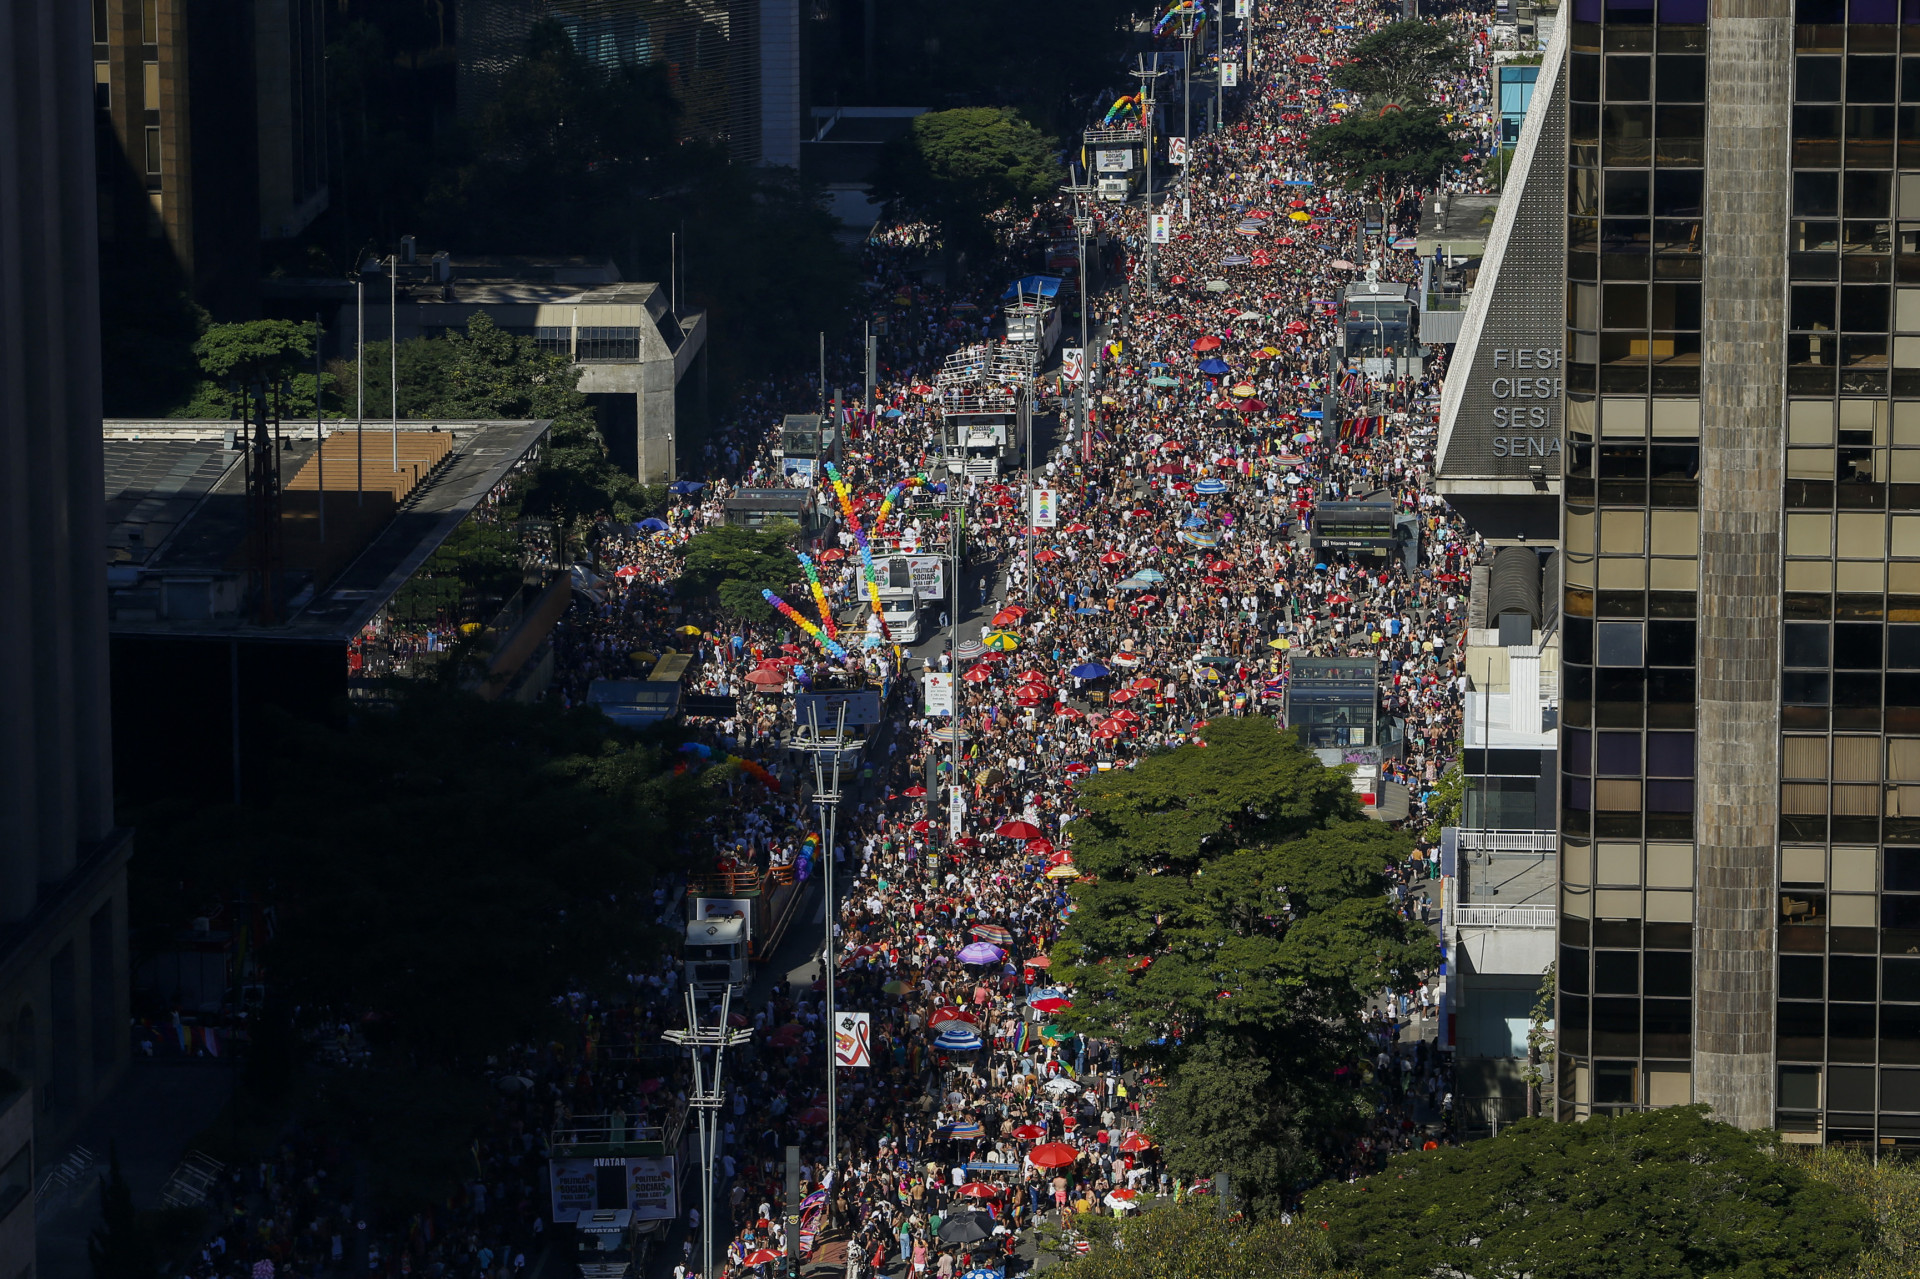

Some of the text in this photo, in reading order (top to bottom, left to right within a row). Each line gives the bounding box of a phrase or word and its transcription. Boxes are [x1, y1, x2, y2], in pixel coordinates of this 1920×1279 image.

[1493, 407, 1551, 428] SESI
[913, 572, 936, 581] SOCIAIS
[593, 1157, 626, 1167] AVATAR
[560, 1184, 590, 1194] SOCIAIS
[635, 1183, 666, 1192] SOCIAIS
